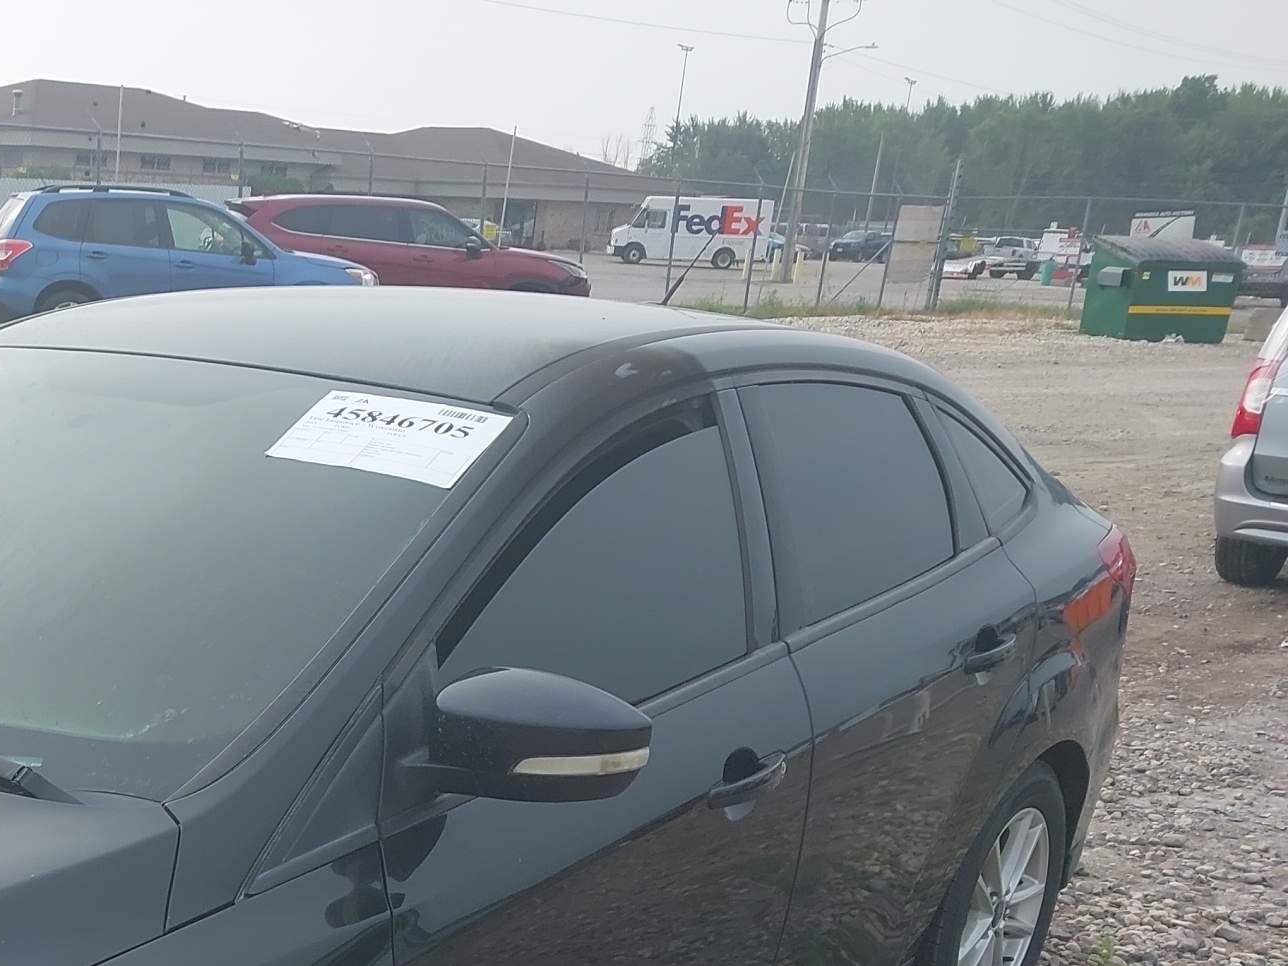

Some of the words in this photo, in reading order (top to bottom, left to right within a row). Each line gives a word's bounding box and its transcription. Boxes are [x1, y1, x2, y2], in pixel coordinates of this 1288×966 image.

[672, 204, 765, 236] FedEx
[1173, 275, 1201, 287] WM
[326, 406, 476, 439] 45846705
